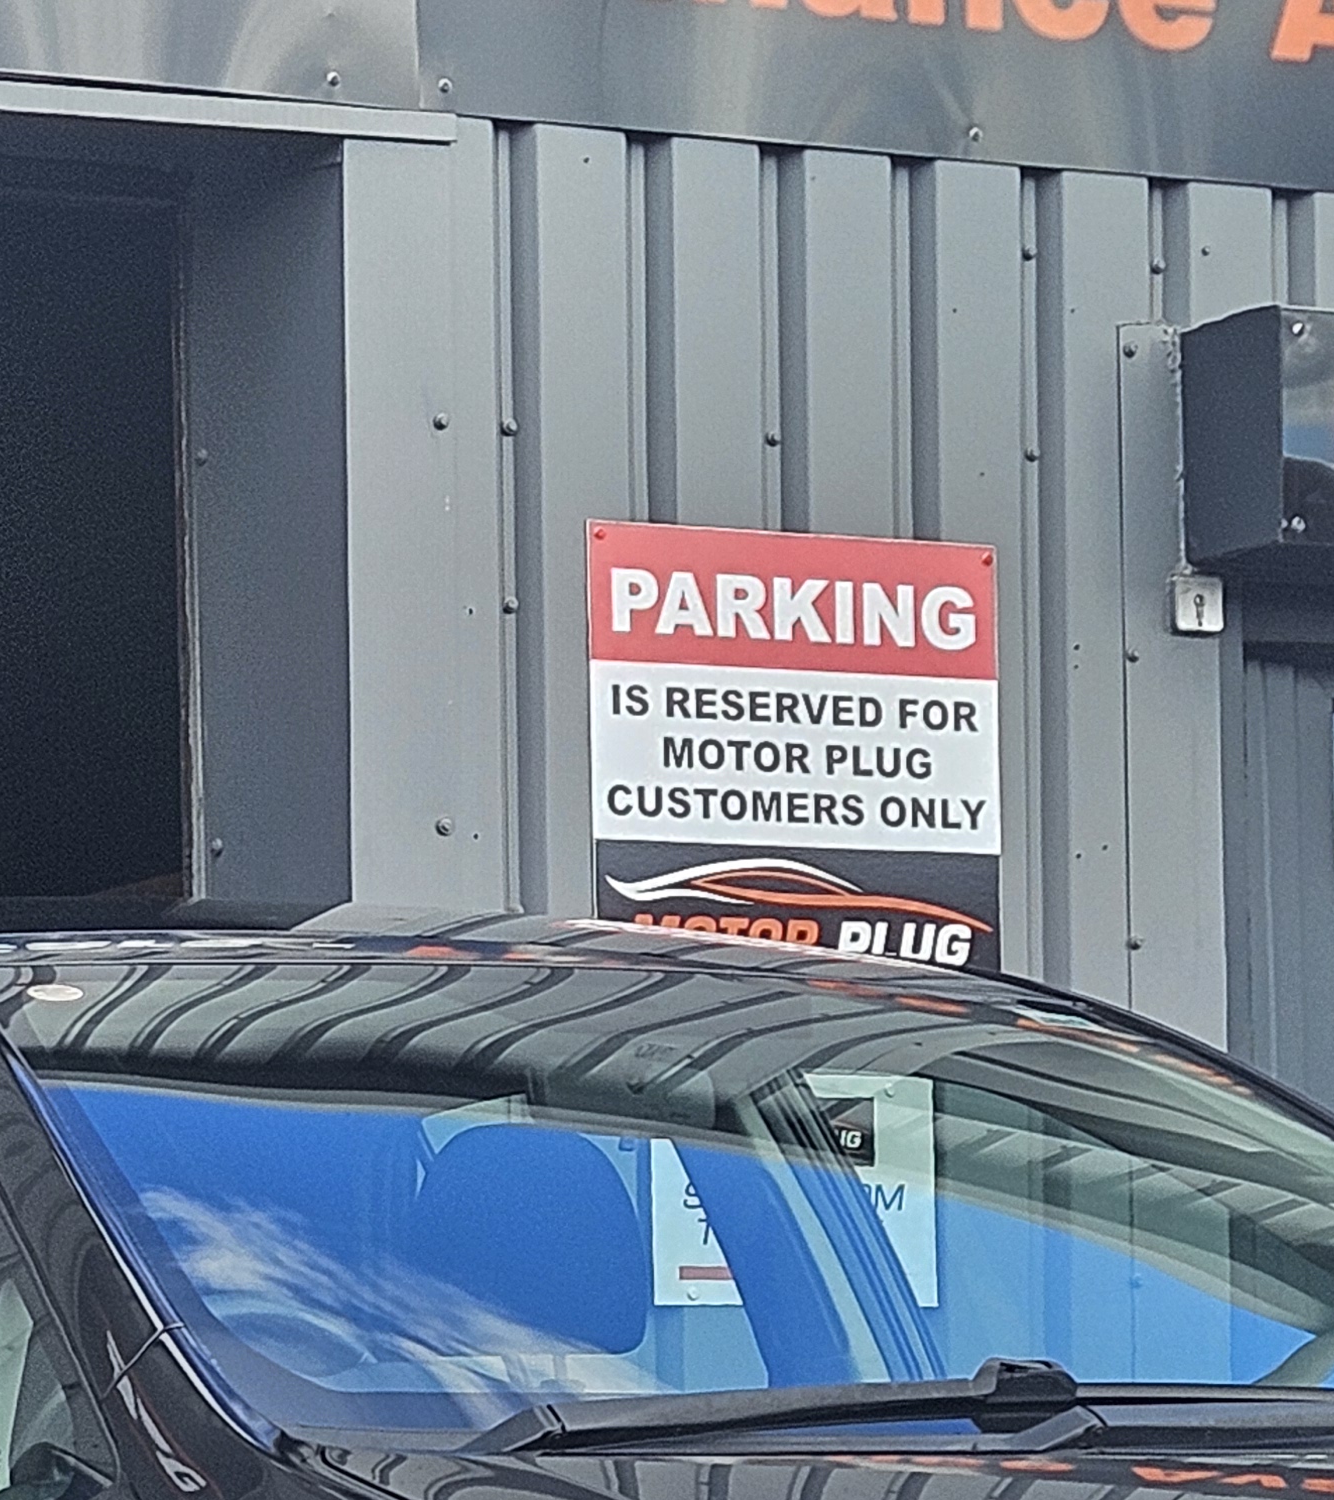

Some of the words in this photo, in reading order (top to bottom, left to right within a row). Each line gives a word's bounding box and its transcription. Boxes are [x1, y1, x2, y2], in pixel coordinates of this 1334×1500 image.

[610, 567, 977, 651] PARKING
[611, 684, 650, 716] IS
[666, 687, 883, 727] RESERVED
[899, 699, 978, 732] FOR
[663, 737, 811, 775] MOTOR
[825, 744, 933, 779] PLUG
[607, 785, 864, 827] CUSTOMERS
[880, 797, 987, 831] ONLY
